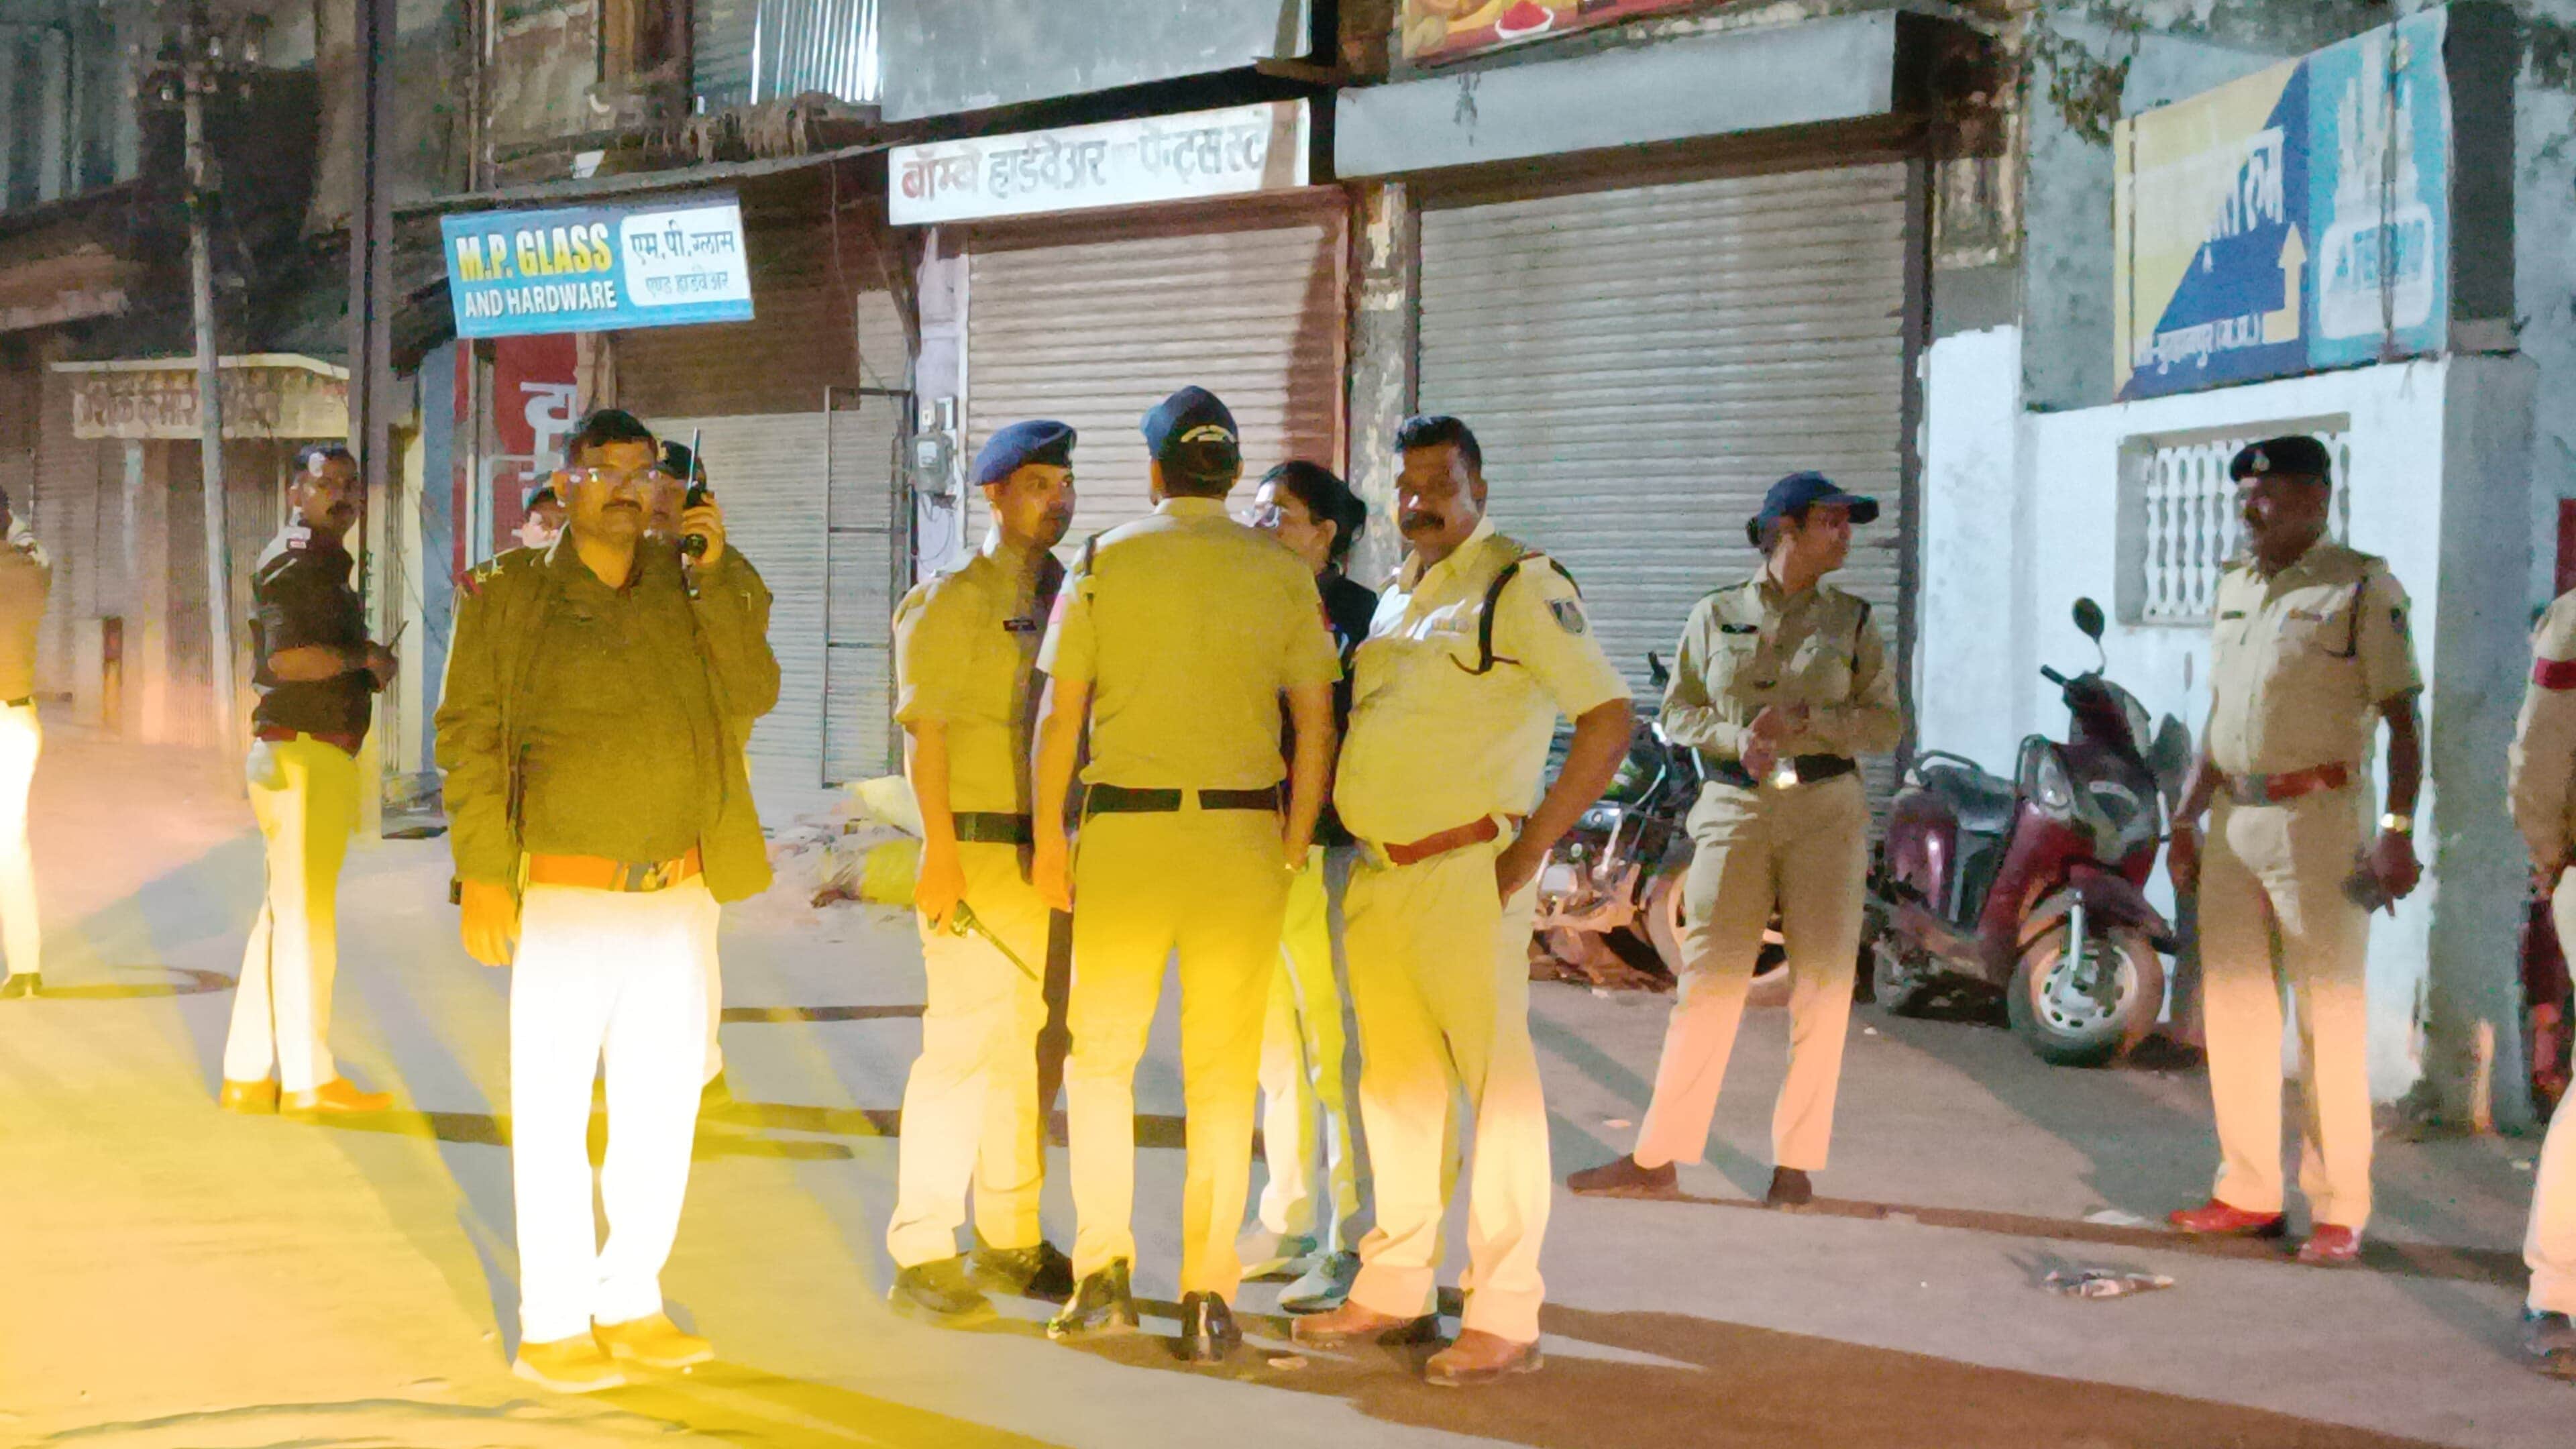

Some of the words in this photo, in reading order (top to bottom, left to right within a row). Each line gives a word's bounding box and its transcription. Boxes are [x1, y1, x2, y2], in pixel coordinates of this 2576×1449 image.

[455, 233, 513, 282] M.P.
[516, 222, 612, 277] GLASS
[465, 289, 503, 318] AND
[506, 280, 617, 315] HARDWARE
